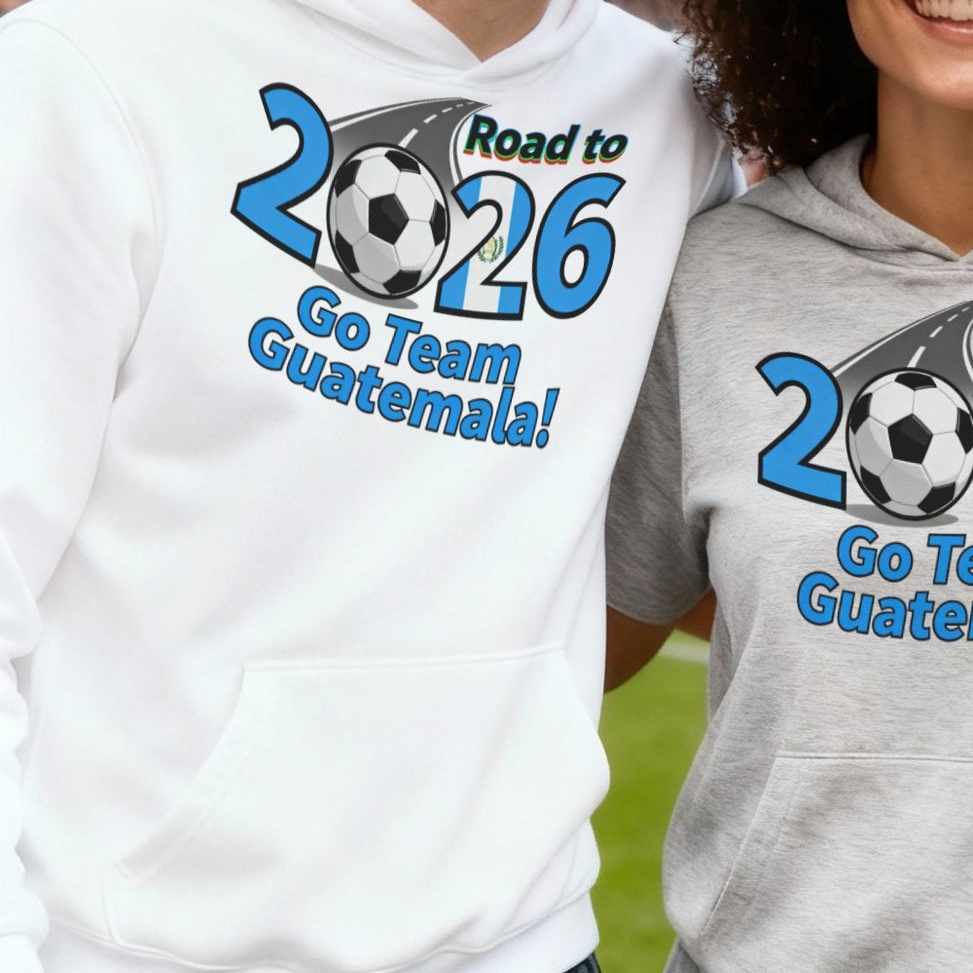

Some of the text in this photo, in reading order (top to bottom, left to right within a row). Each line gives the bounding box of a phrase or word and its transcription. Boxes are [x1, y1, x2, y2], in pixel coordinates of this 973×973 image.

[463, 114, 629, 165] Road to
[297, 285, 522, 385] Go Team
[248, 317, 560, 449] Guatemala!
[837, 524, 913, 582] Go
